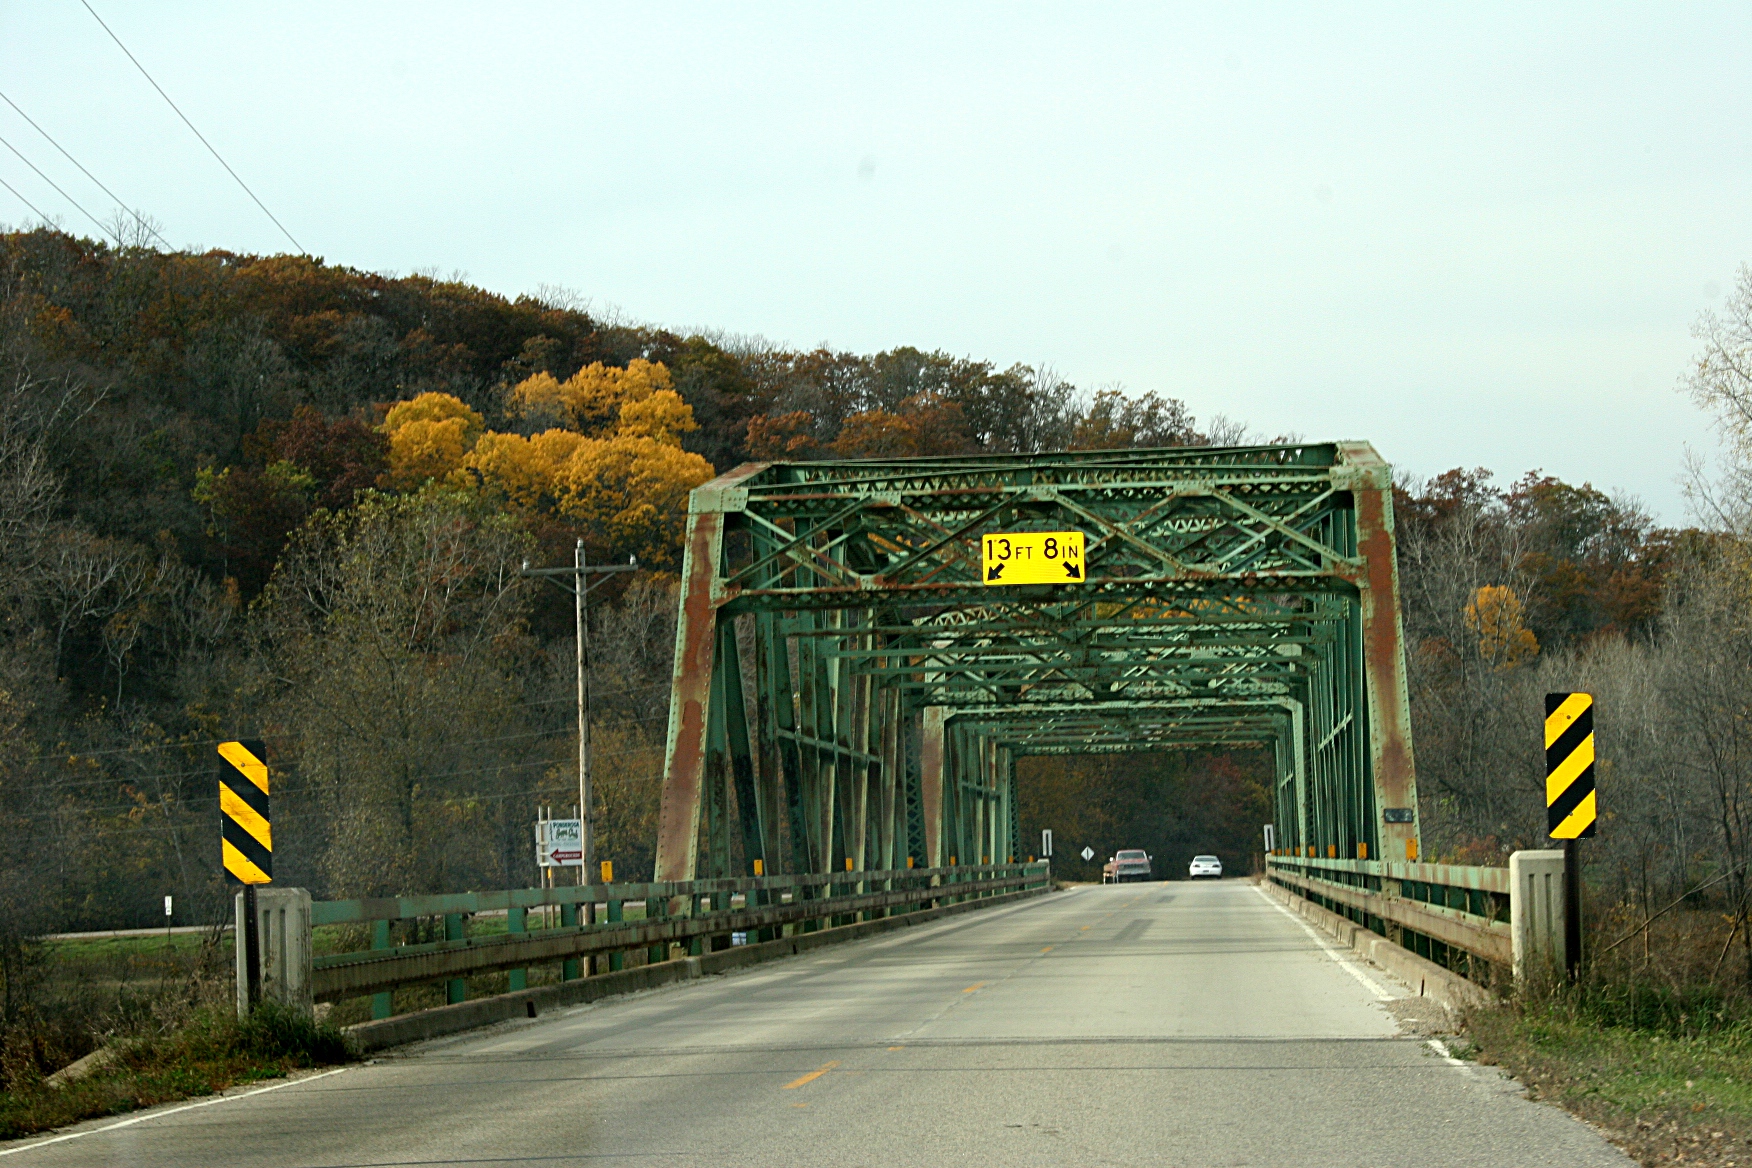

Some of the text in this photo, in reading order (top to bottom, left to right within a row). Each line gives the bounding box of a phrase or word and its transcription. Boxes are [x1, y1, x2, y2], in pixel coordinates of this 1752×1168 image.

[987, 537, 1078, 560] 13 FT 8 IN
